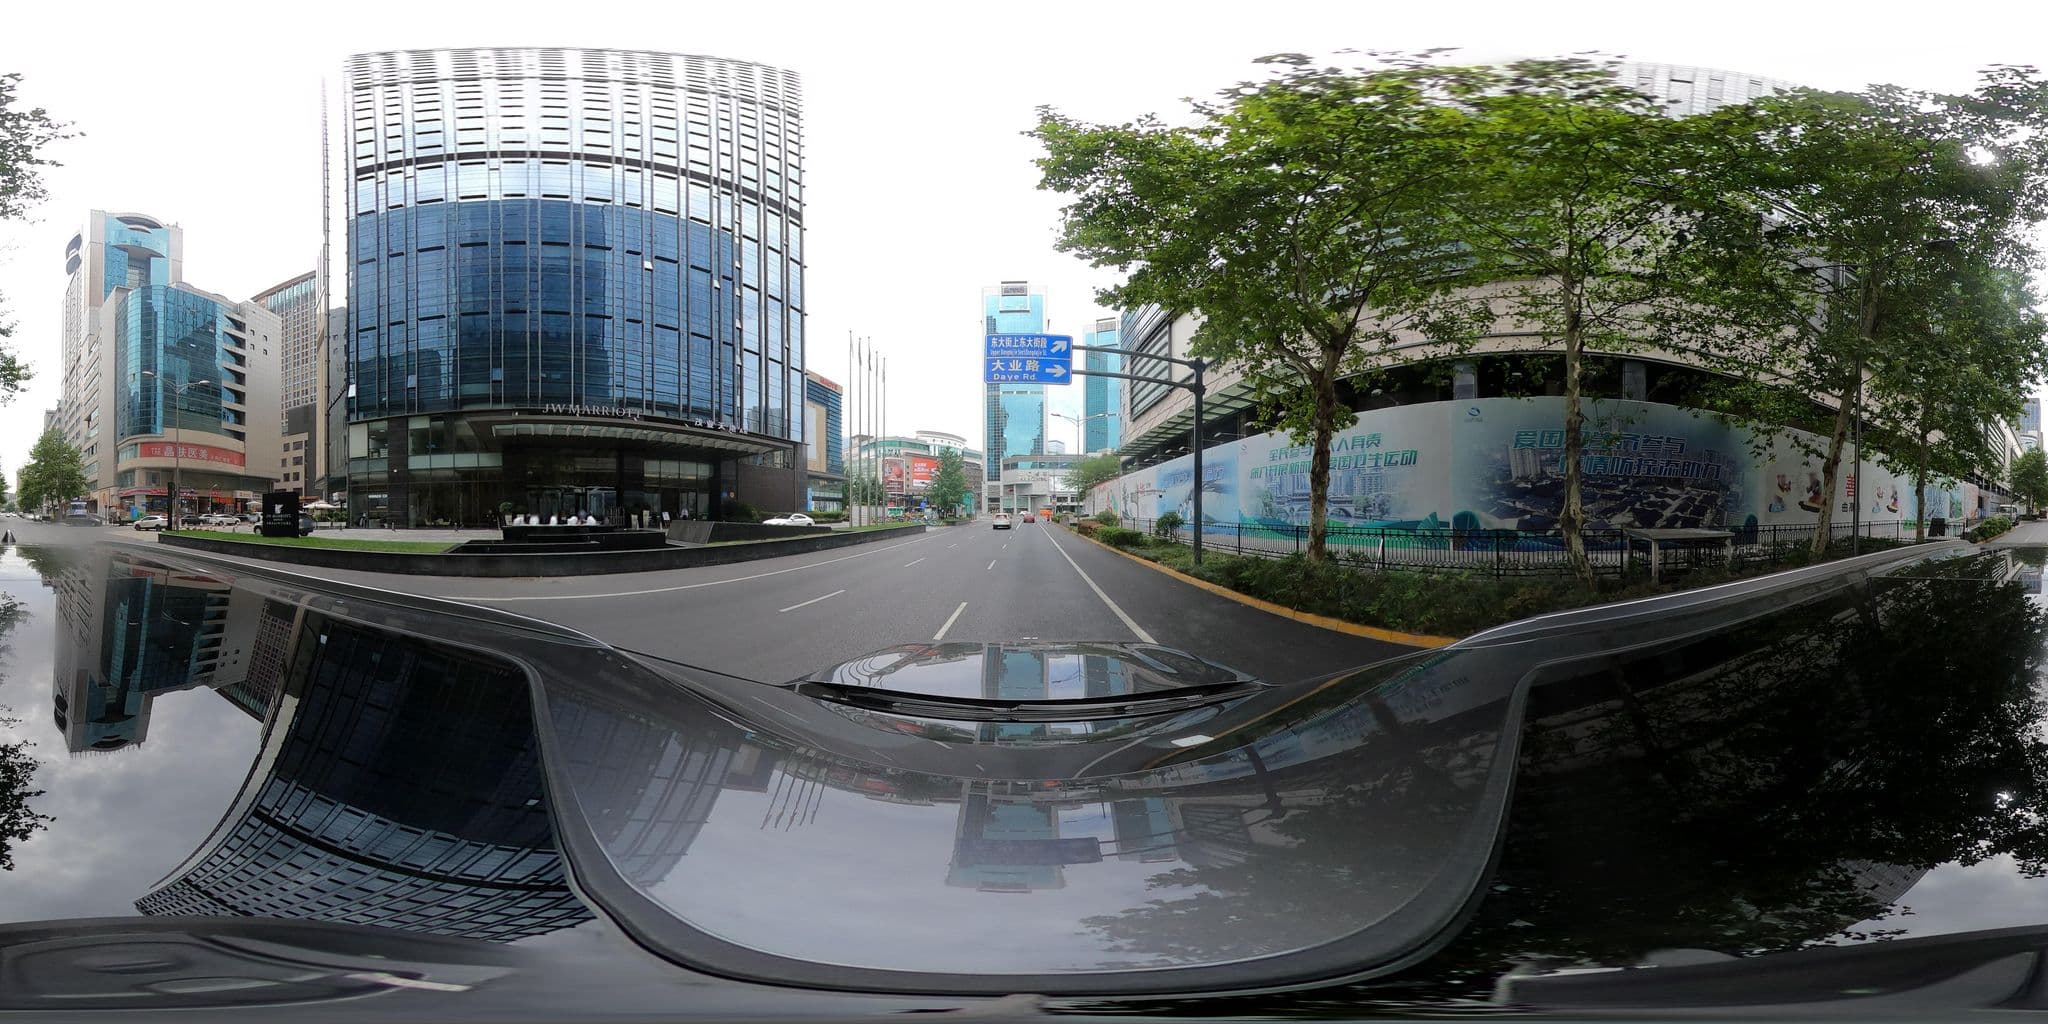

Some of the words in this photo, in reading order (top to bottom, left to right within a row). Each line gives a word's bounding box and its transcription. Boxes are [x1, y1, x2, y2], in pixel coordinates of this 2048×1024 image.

[991, 360, 1039, 372] 大业路
[993, 373, 1019, 381] Daye
[542, 403, 566, 414] JW
[568, 404, 642, 419] MARRIOTT
